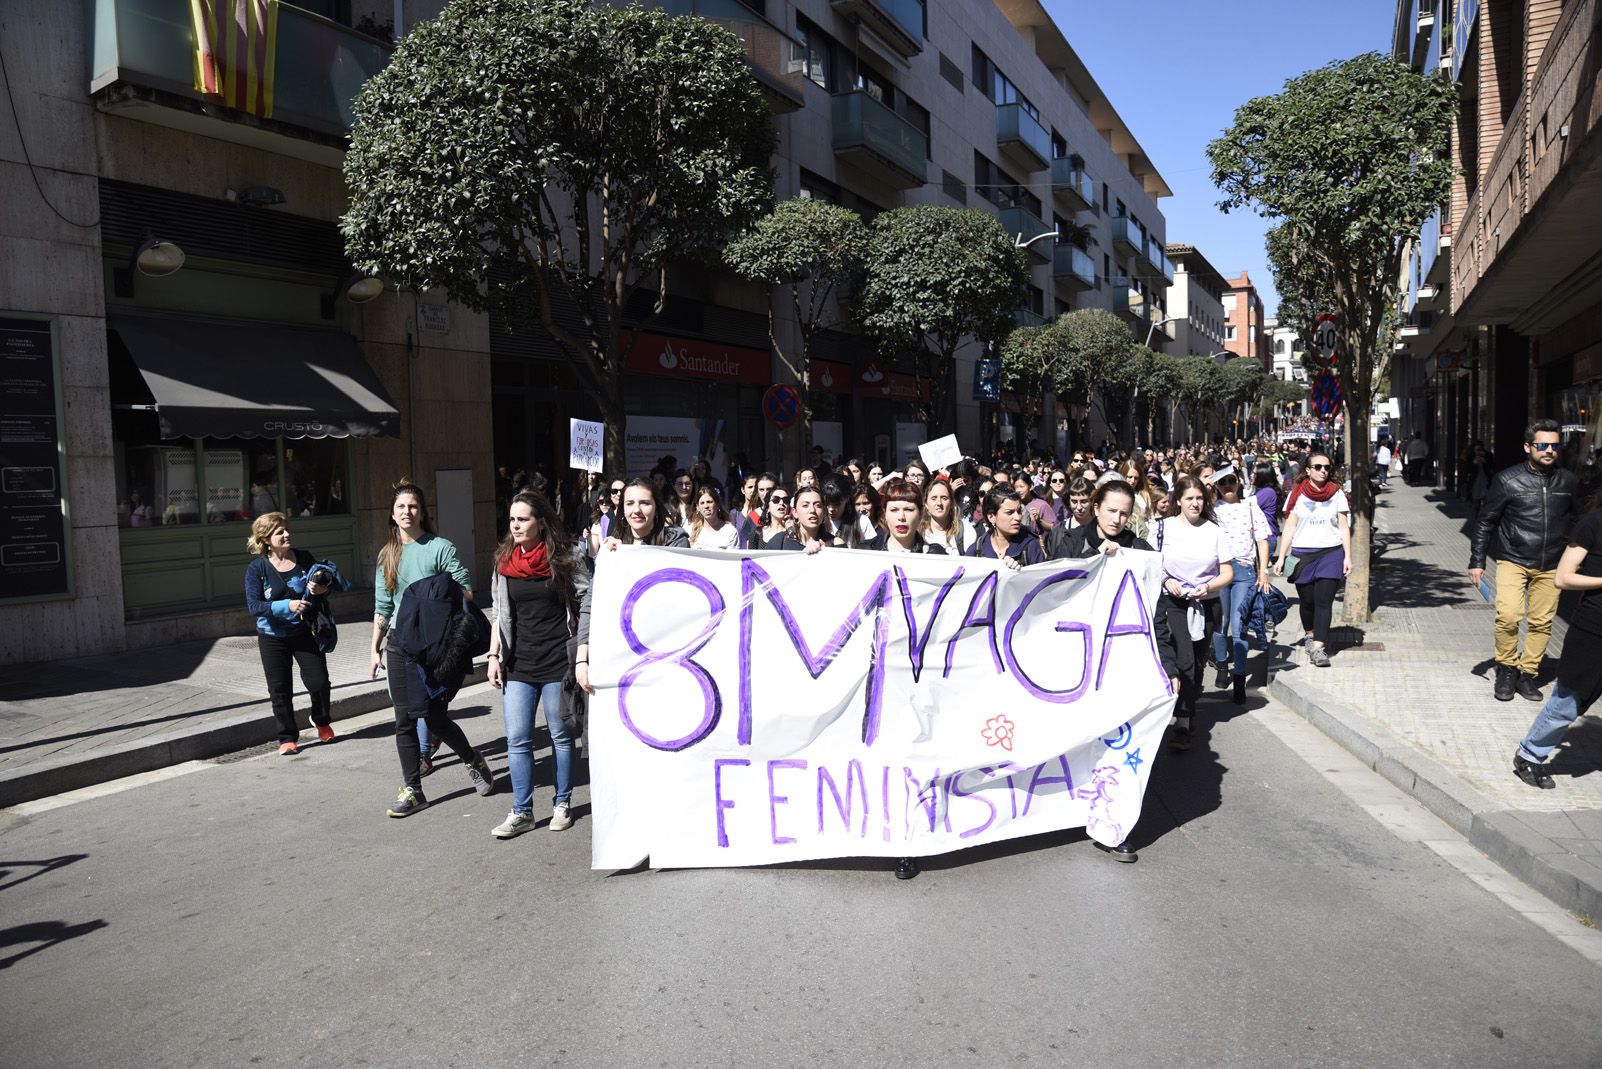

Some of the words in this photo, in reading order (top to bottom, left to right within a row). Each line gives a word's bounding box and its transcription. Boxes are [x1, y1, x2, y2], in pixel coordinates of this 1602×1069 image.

[1316, 328, 1336, 350] 40
[679, 347, 741, 376] Santander
[979, 364, 995, 385] P
[577, 423, 598, 435] VIVAS
[626, 432, 648, 443] Avolem
[617, 557, 892, 752] 8M
[893, 564, 1174, 704] VAGA
[714, 753, 1077, 848] FEMINISTA
